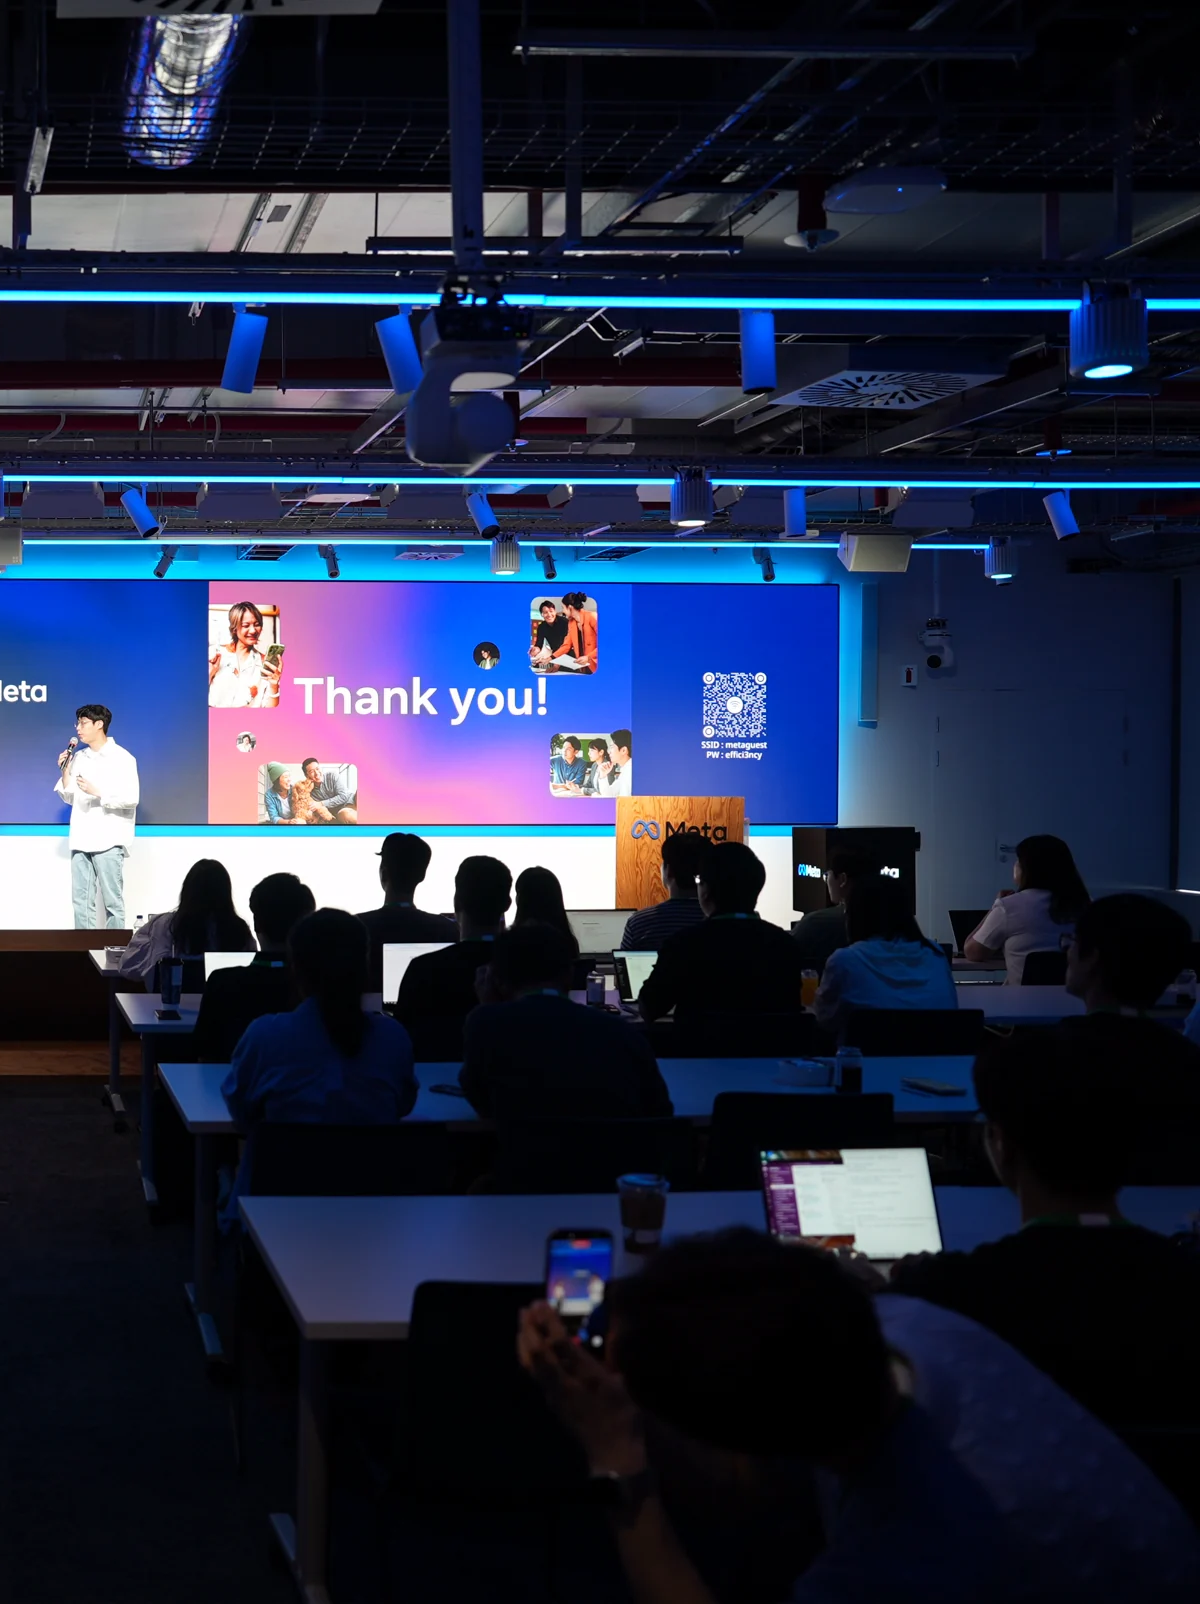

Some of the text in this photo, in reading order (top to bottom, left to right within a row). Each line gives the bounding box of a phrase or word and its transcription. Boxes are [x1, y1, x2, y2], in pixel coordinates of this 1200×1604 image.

[293, 676, 548, 726] Thank you!
[701, 741, 720, 749] SSID
[725, 741, 768, 751] metaguest
[706, 751, 720, 759] PW
[725, 750, 763, 761] effici3ncy
[805, 864, 821, 878] Meta
